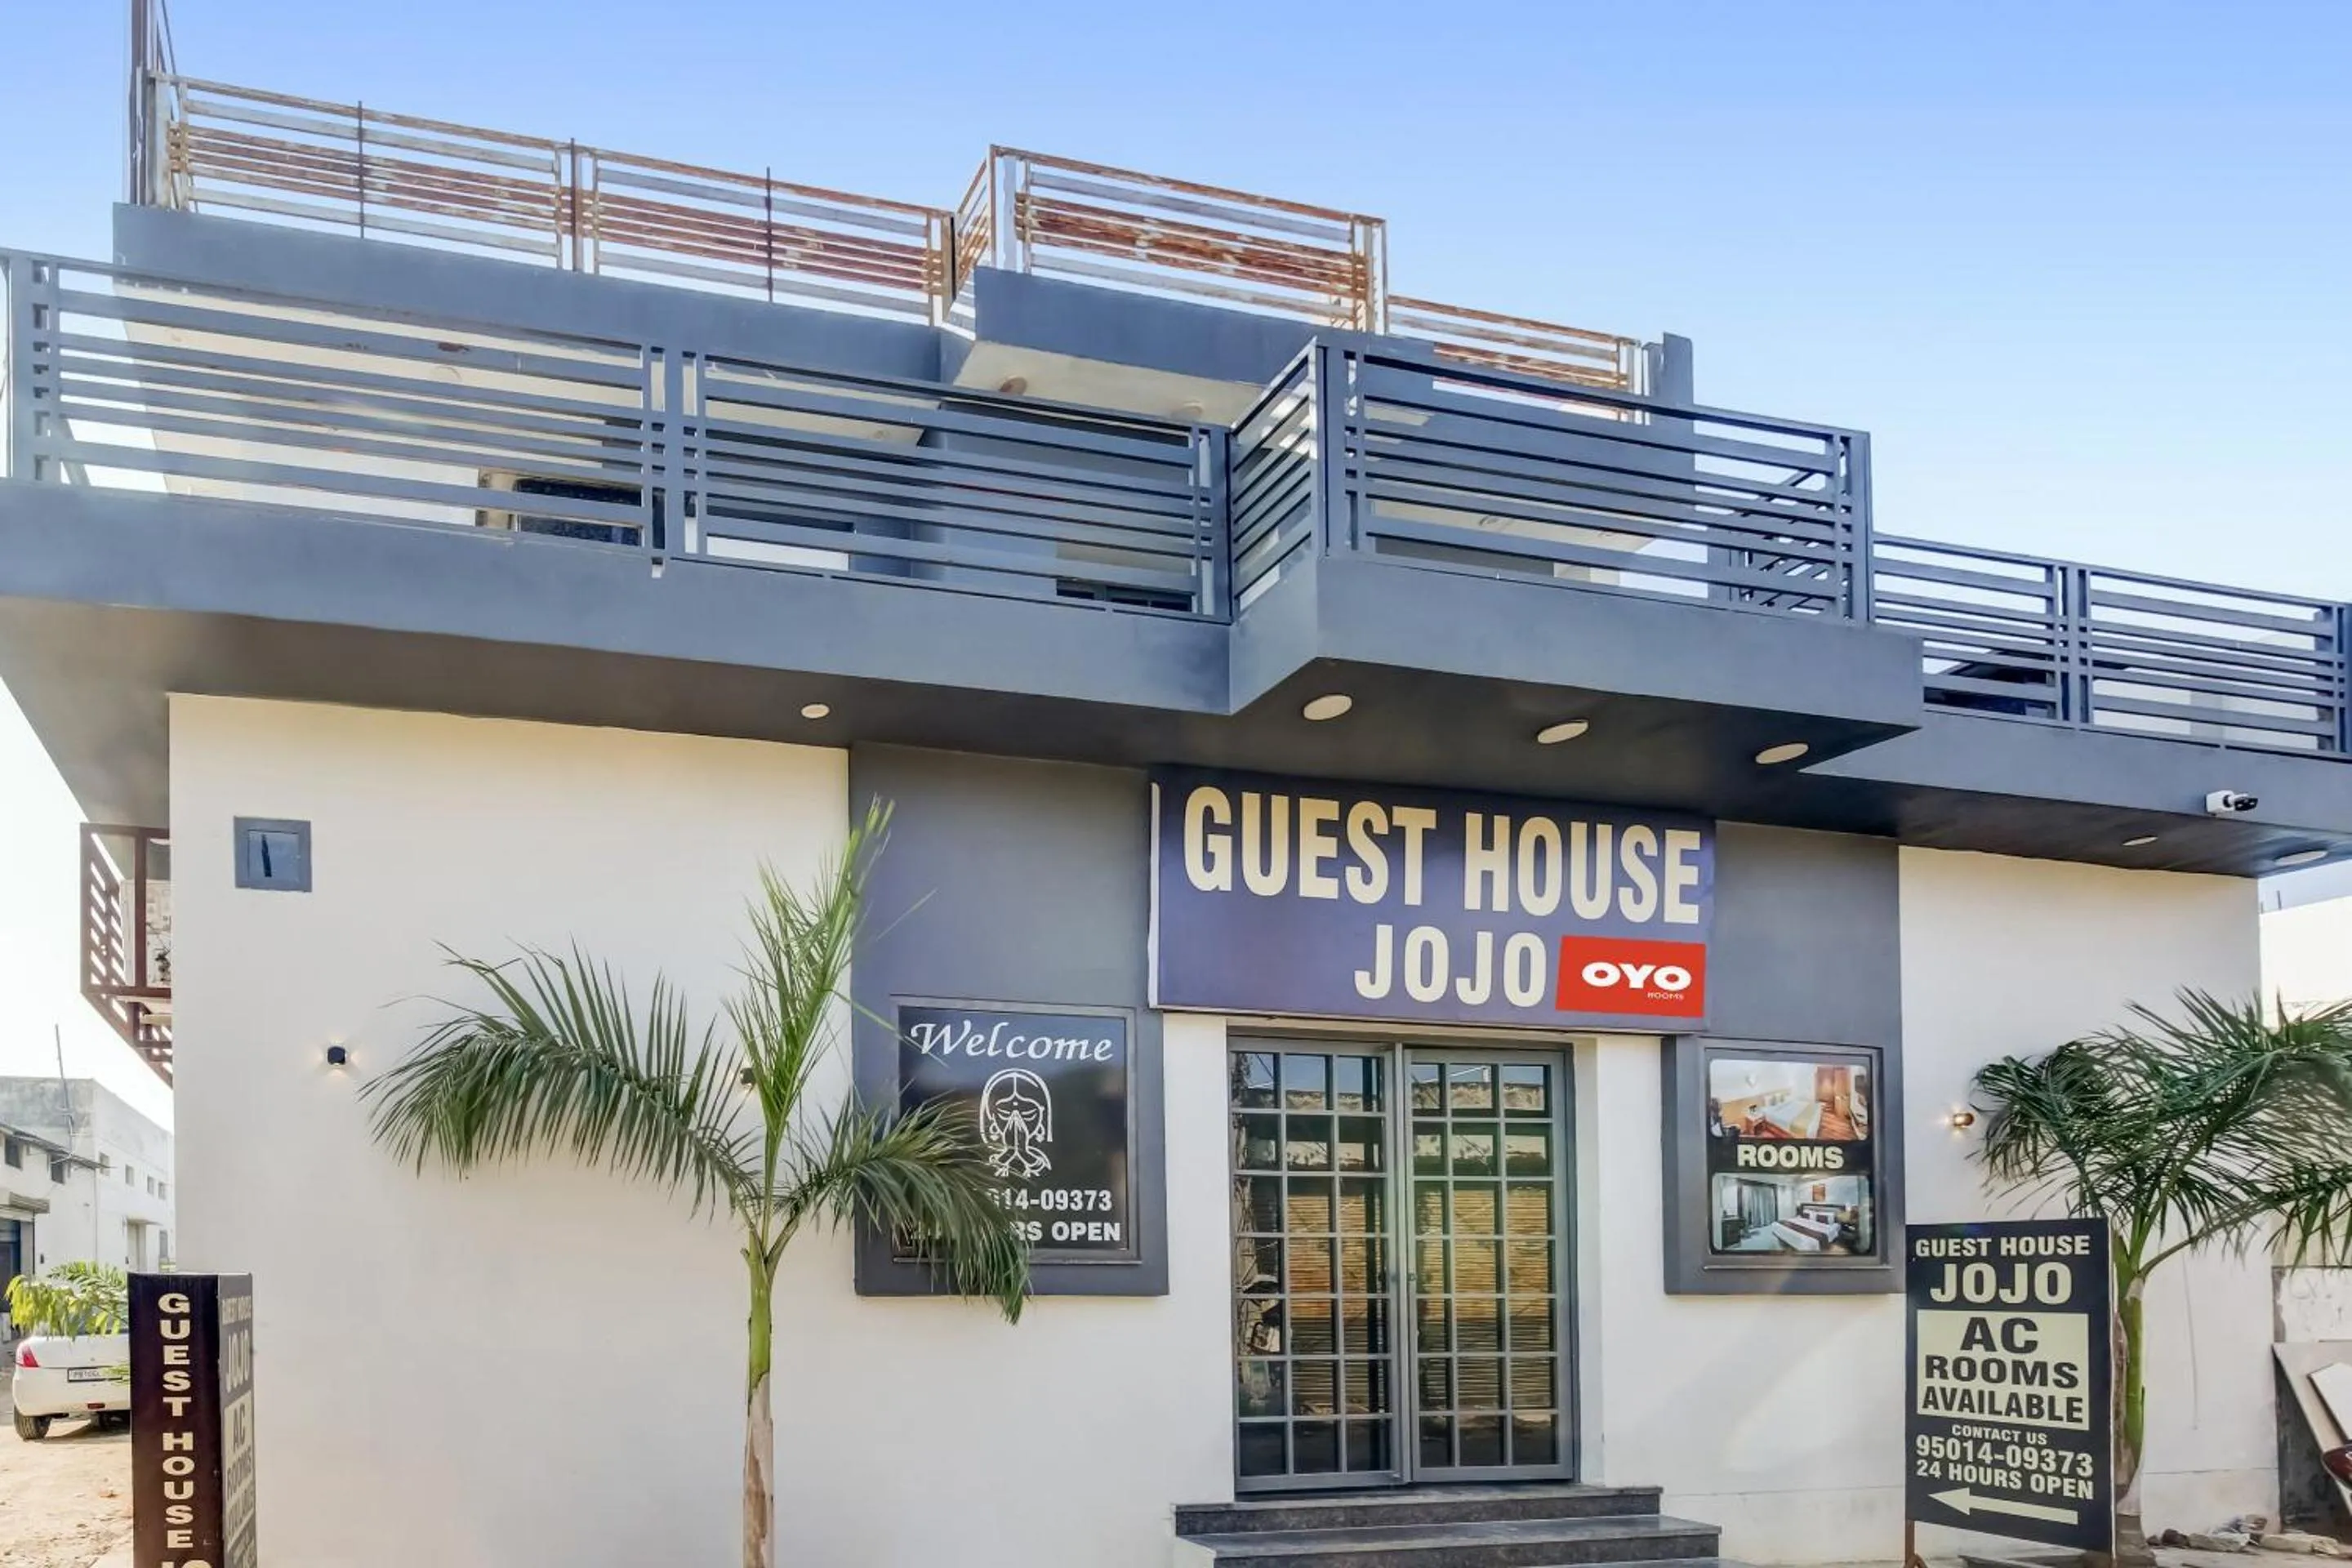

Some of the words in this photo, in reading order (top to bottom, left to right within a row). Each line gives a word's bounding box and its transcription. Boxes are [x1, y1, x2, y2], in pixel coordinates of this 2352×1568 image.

[1184, 786, 1436, 906] GUEST
[1463, 812, 1699, 924] HOUSE
[1353, 924, 1547, 1008] JOJO
[1582, 962, 1691, 991] OYO
[1647, 991, 1684, 1000] ROOMS
[911, 1020, 1113, 1061] Welcome
[1737, 1144, 1844, 1169] ROOMS
[1051, 1221, 1120, 1241] OPEN
[1915, 1238, 1992, 1257] GUEST
[2001, 1235, 2090, 1256] HOUSE
[1930, 1262, 2072, 1304] JOJO
[1960, 1316, 2038, 1353] AC
[158, 1293, 192, 1417] GUEST
[1925, 1355, 2078, 1388] ROOMS
[1922, 1386, 2082, 1423] AVAILABLE
[1952, 1424, 2021, 1443] CONTACT
[2026, 1432, 2047, 1446] US
[1916, 1434, 2094, 1477] 95014-09373
[163, 1432, 195, 1548] HOUSE
[1916, 1459, 1942, 1479] 24
[1949, 1463, 2022, 1490] HOURS
[2030, 1473, 2094, 1499] OPEN
